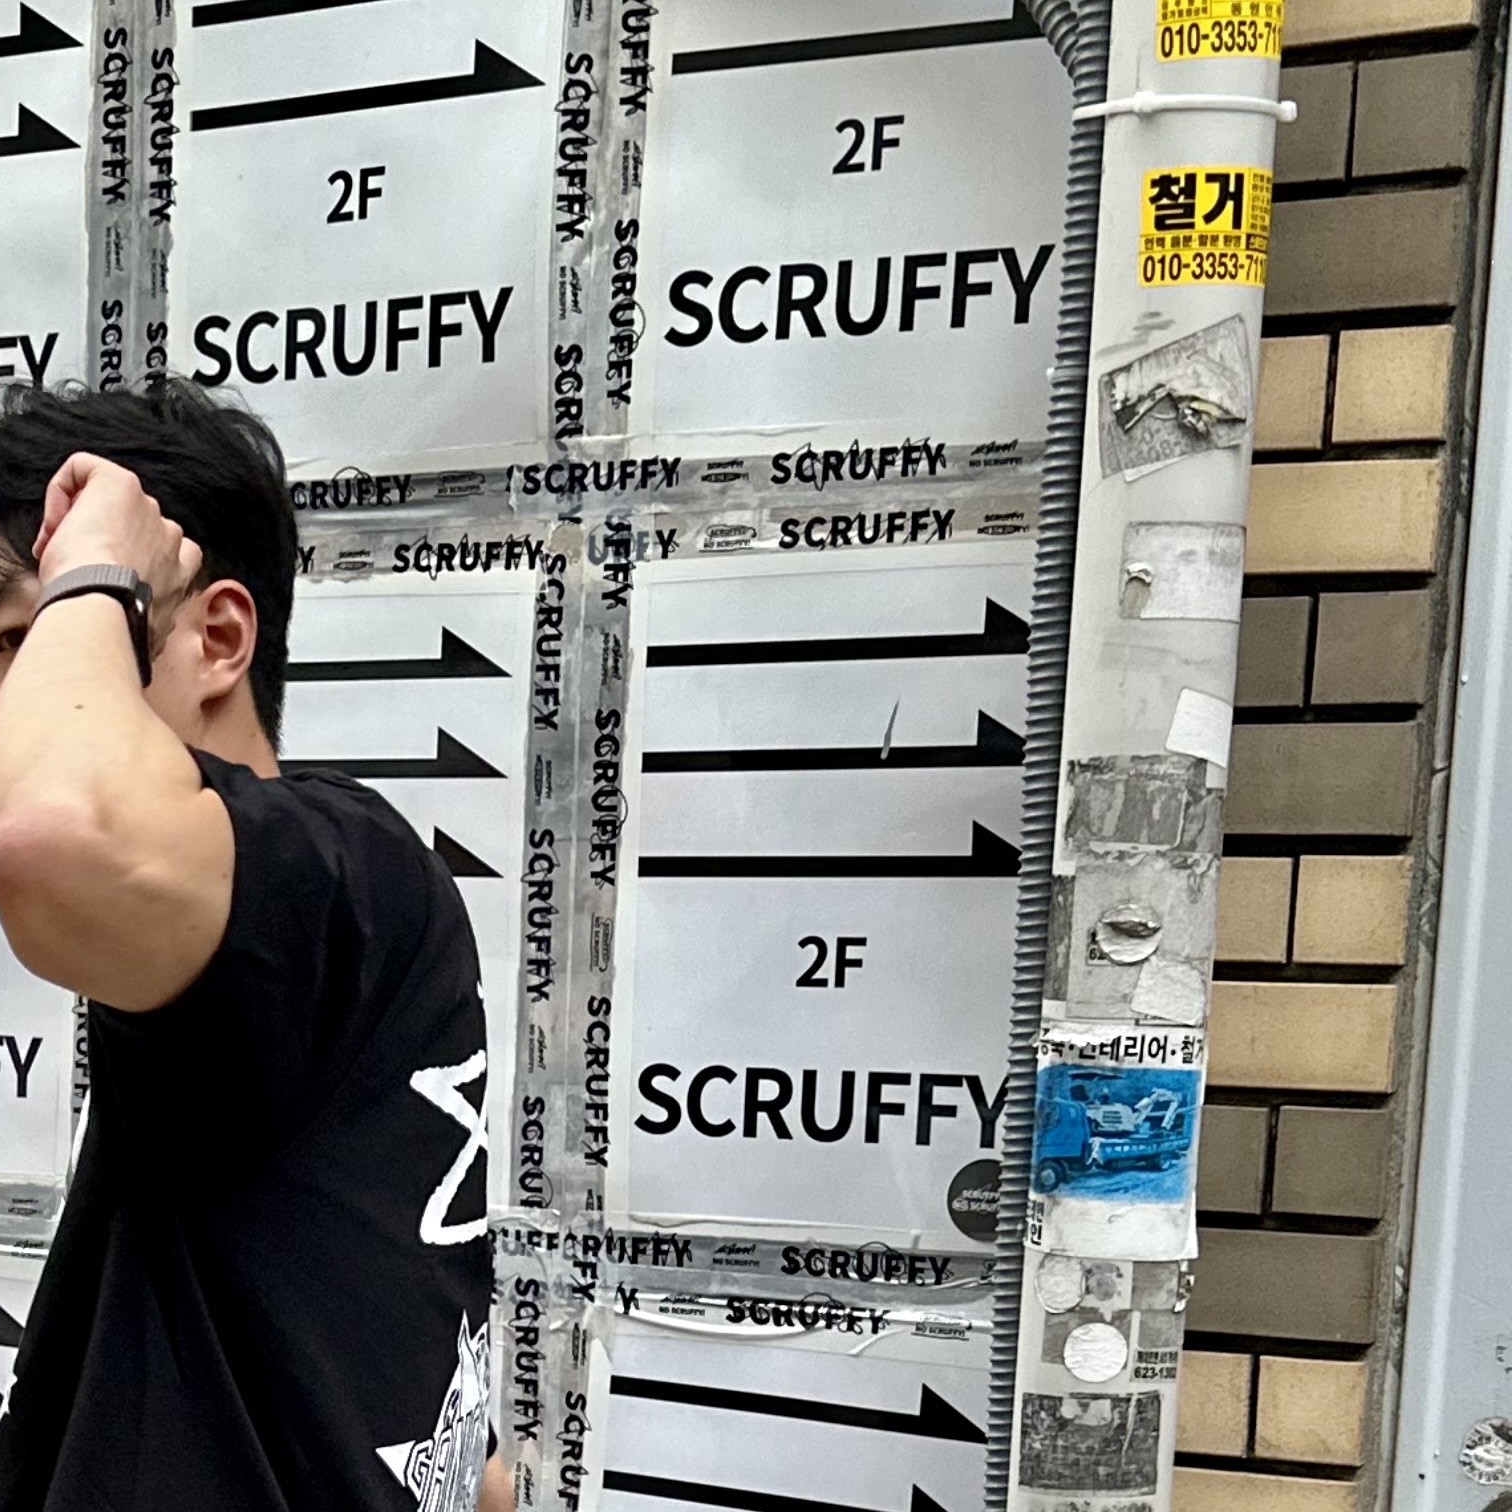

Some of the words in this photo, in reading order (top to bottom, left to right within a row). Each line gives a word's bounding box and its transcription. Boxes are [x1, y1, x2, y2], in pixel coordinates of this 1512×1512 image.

[833, 115, 904, 174] 2F
[327, 166, 385, 223] 2F
[1149, 172, 1244, 231] 철거
[665, 244, 1055, 347] SCRUFFY
[192, 286, 514, 387] SCRUFFY
[292, 475, 413, 509] CRUFFY
[796, 936, 867, 988] 2F
[634, 1063, 1008, 1149] SCRUFFY
